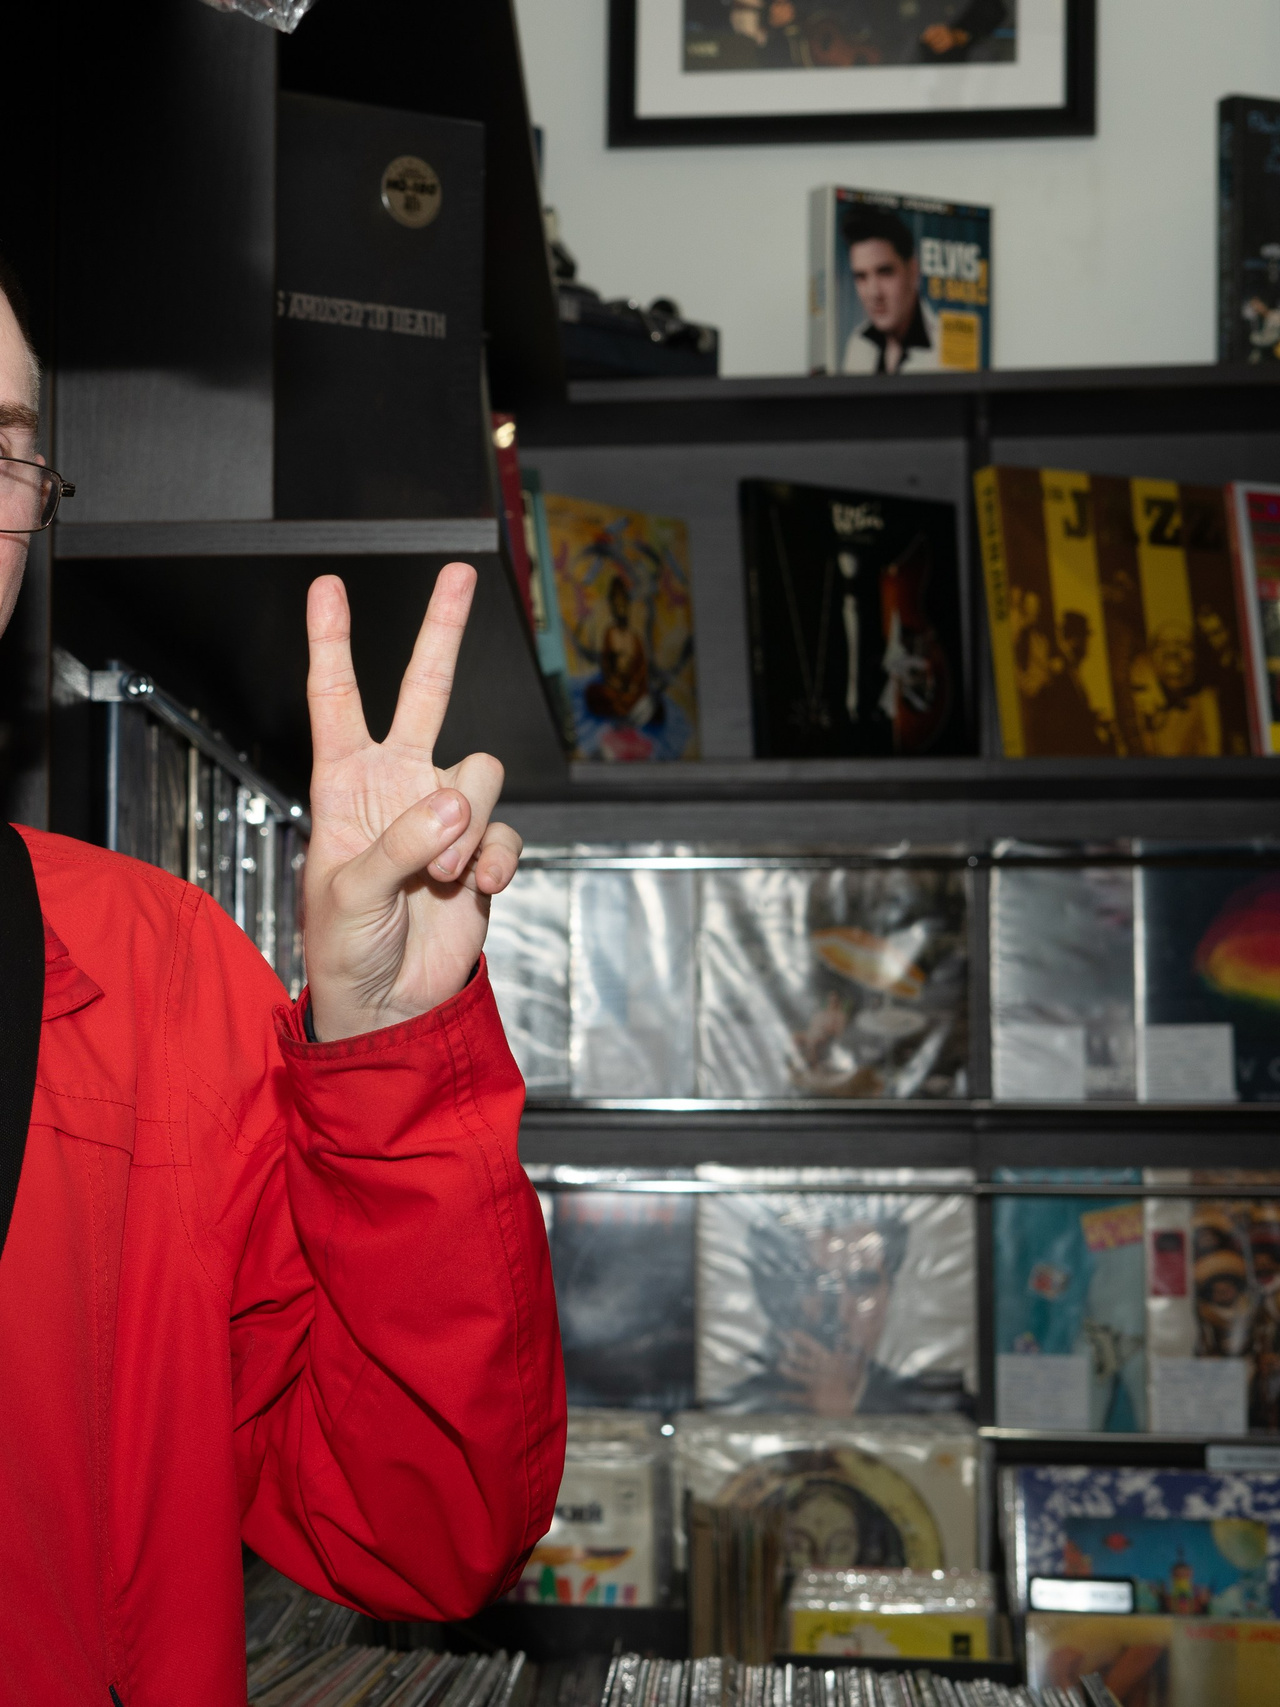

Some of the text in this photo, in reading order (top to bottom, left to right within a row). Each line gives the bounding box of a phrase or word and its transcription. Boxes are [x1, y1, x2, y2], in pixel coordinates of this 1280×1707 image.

[920, 238, 982, 283] ELVIS
[287, 292, 363, 328] AMUSED
[362, 301, 388, 331] TO
[388, 304, 447, 339] DEATH
